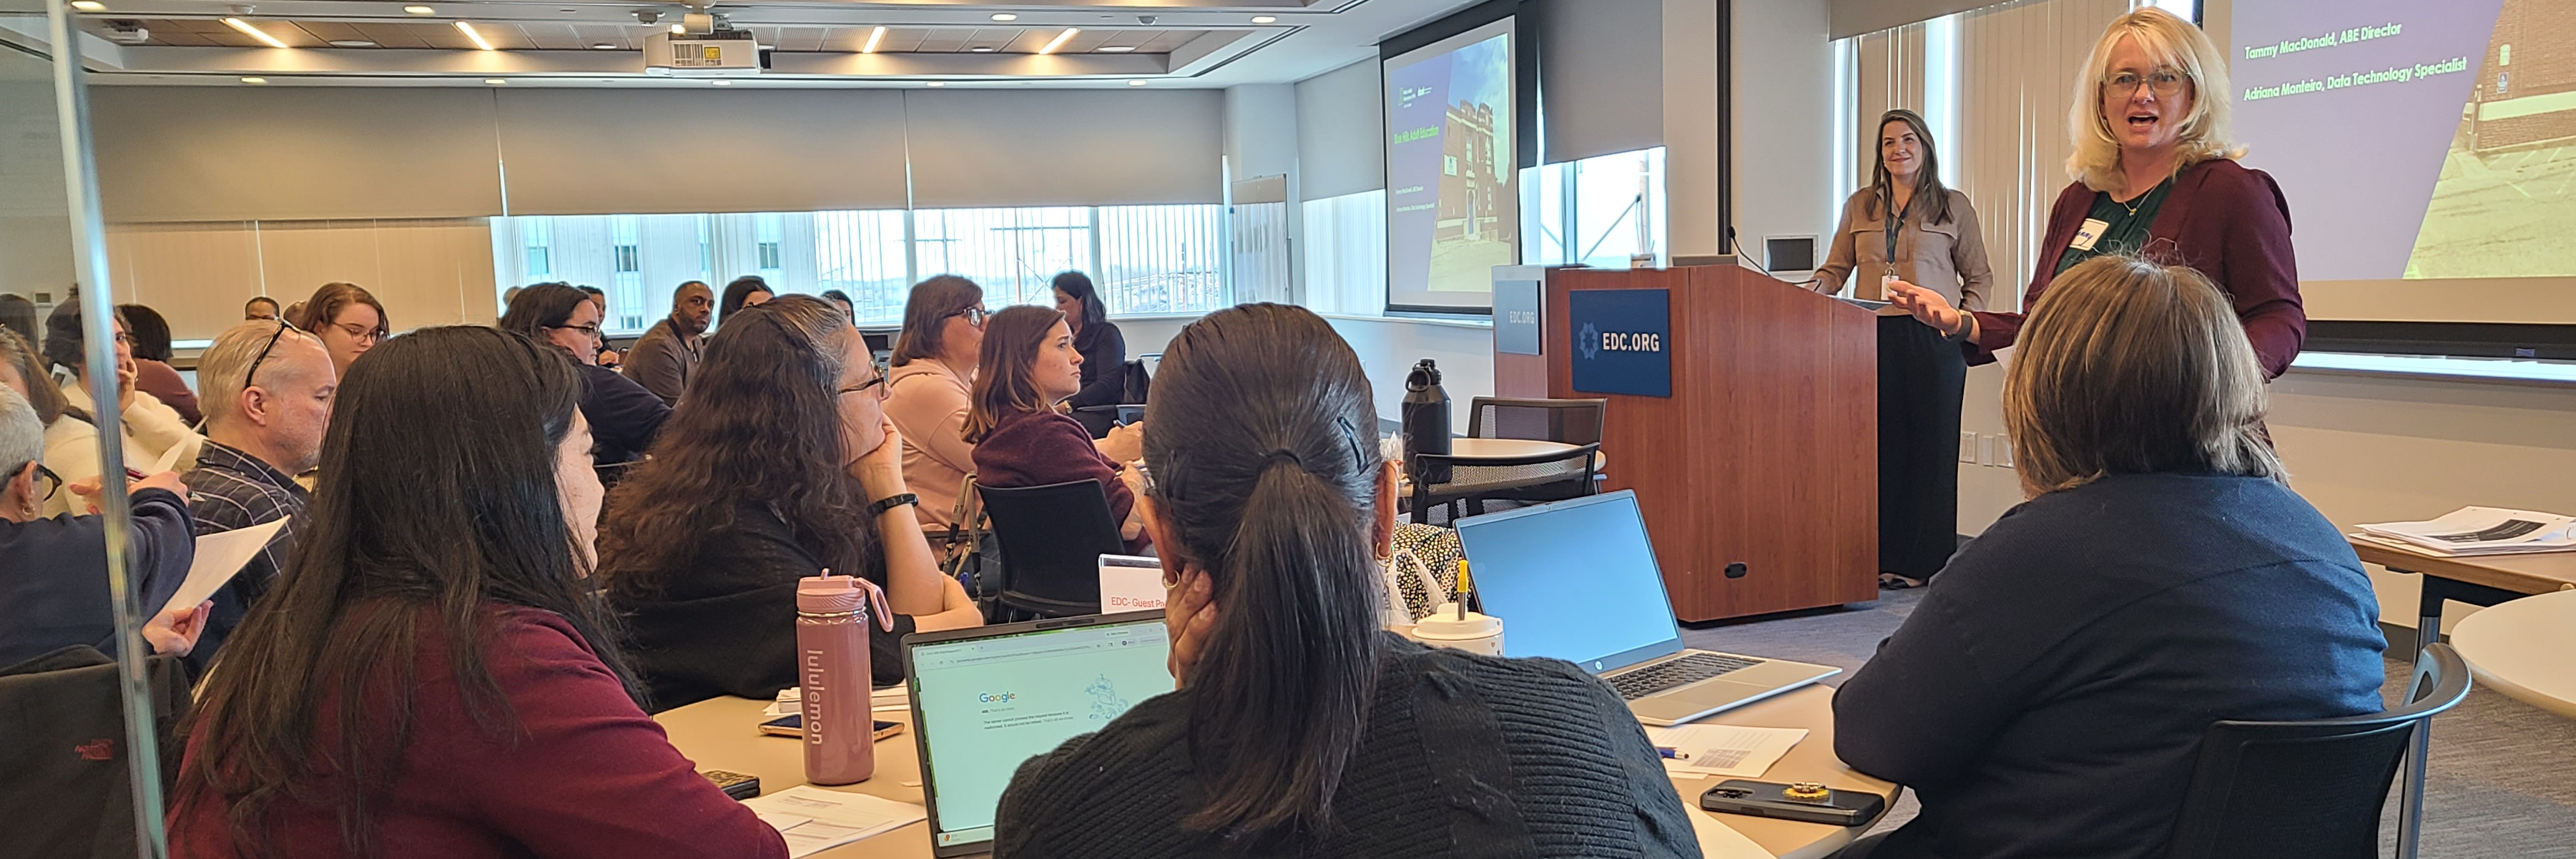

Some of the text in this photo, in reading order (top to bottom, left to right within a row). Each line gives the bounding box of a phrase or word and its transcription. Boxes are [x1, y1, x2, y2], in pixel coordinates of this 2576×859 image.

[2245, 22, 2402, 59] Tammy MacDonald, ABE Director
[2243, 57, 2467, 102] Adriana Monteiro, Data Technology Specialist
[1509, 310, 1535, 324] EDC.ORG
[1603, 333, 1660, 352] EDC.ORG
[1111, 597, 1165, 608] EDC- Guest Pa
[807, 649, 825, 745] lululemon
[979, 691, 1016, 703] Google
